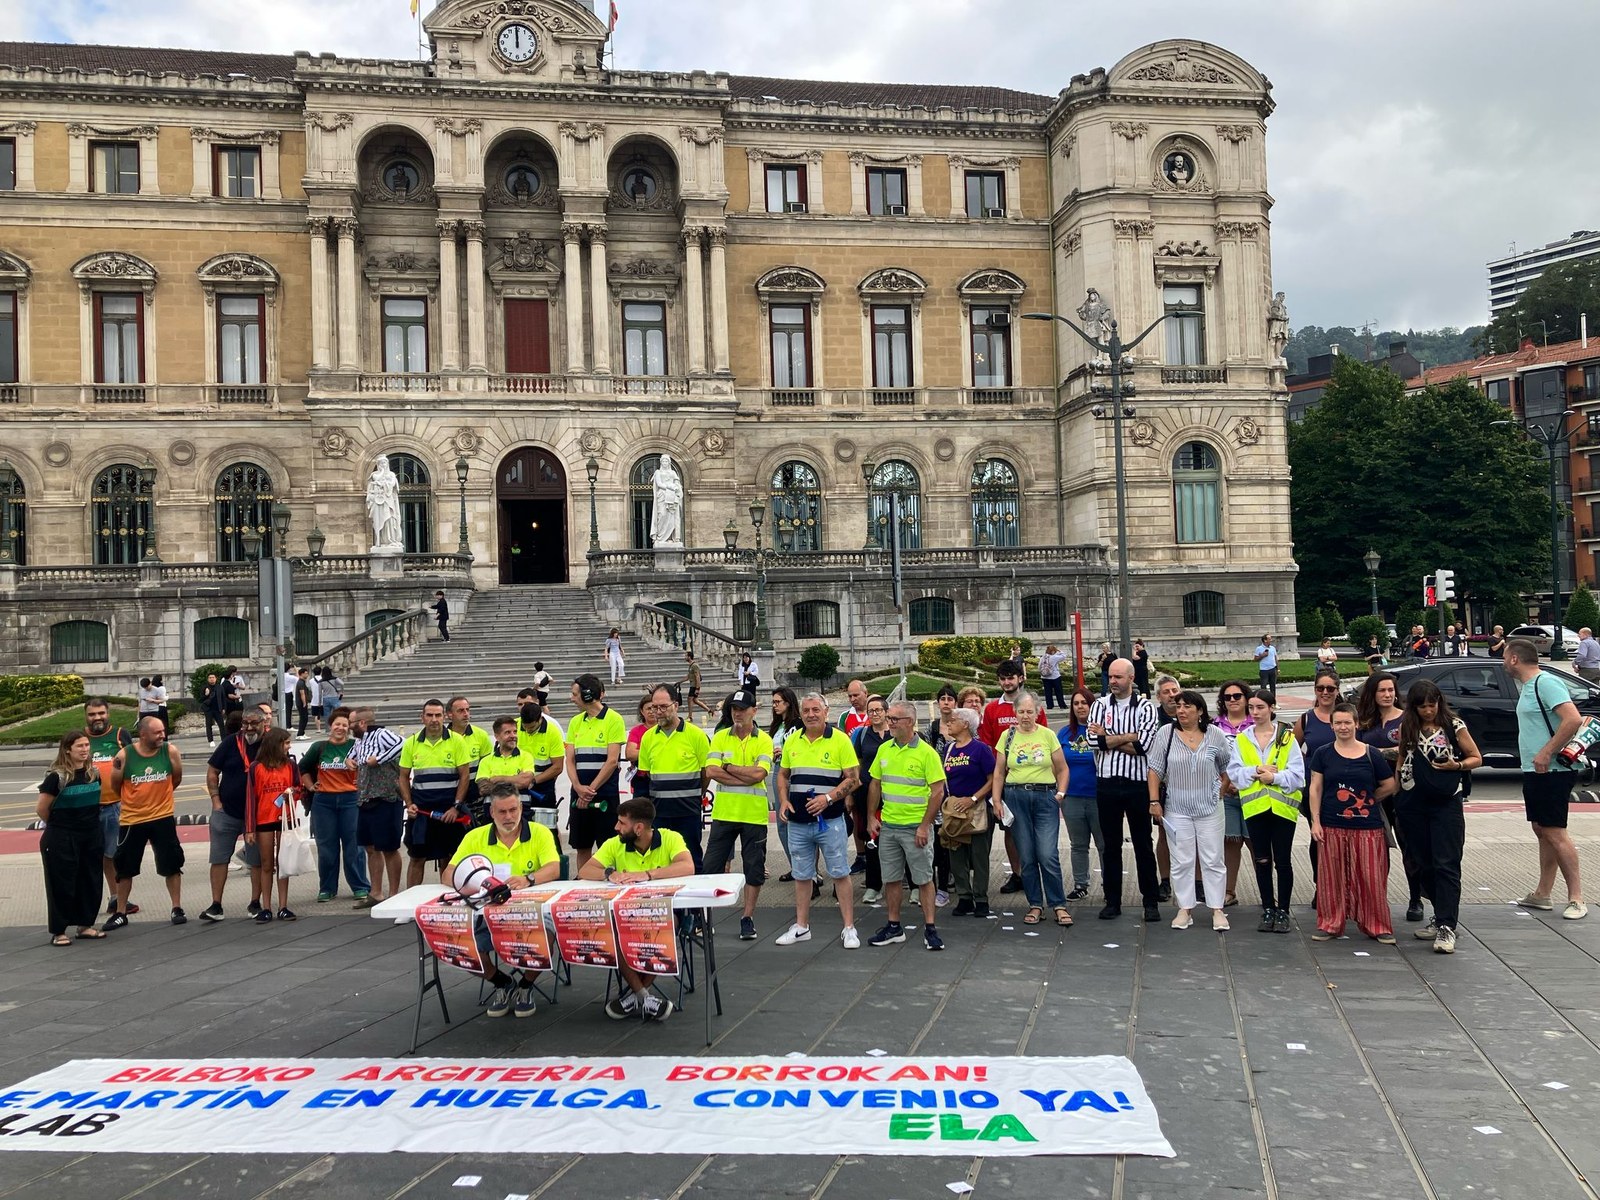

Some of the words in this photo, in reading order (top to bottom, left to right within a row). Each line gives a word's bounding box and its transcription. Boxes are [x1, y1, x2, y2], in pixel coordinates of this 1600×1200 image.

[489, 912, 538, 921] GREBAN
[556, 909, 606, 918] GREBAN
[618, 907, 668, 917] GREBAN
[102, 1067, 315, 1084] BILBOKO
[338, 1066, 627, 1083] ARGITERIA
[666, 1065, 988, 1084] BORROKAN!
[0, 1086, 290, 1110] E.MARTÍN
[304, 1089, 397, 1110] EN
[412, 1089, 661, 1111] HUELGA,
[694, 1090, 1001, 1110] CONVENIO
[1021, 1090, 1136, 1114] YA!
[0, 1113, 120, 1136] LAB
[888, 1113, 1038, 1143] ELA
